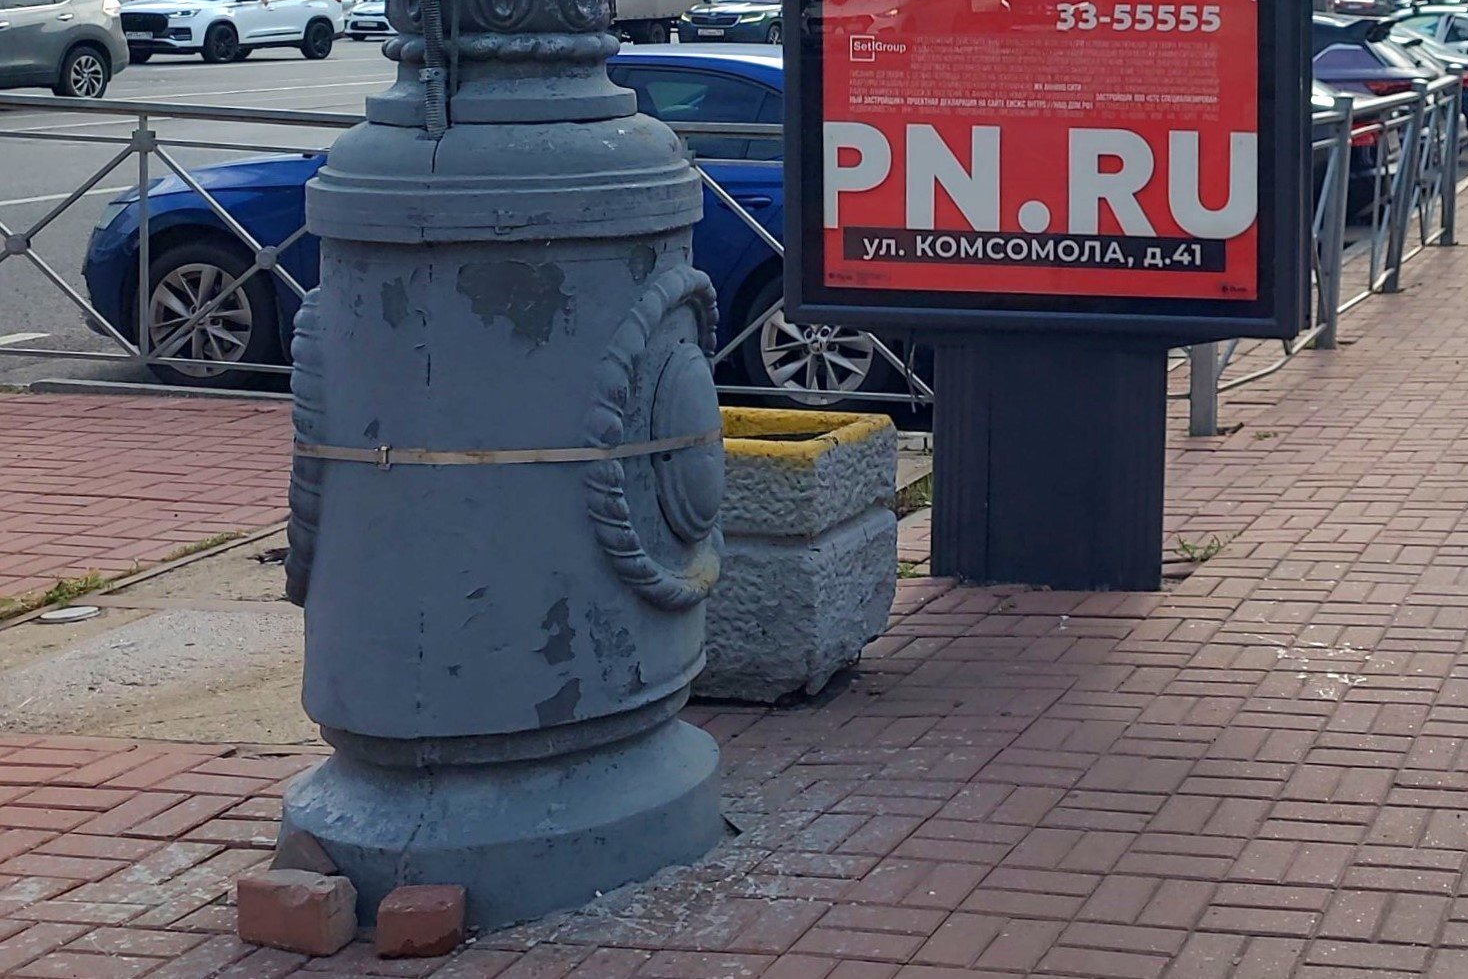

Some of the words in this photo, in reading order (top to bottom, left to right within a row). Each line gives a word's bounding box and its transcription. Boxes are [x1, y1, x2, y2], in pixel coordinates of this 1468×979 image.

[1056, 1, 1221, 32] 33-55555
[822, 121, 1258, 239] PN.RU
[863, 238, 905, 260] ул.
[916, 235, 1134, 267] КОМСОМОЛА,
[1144, 243, 1202, 268] д.41
